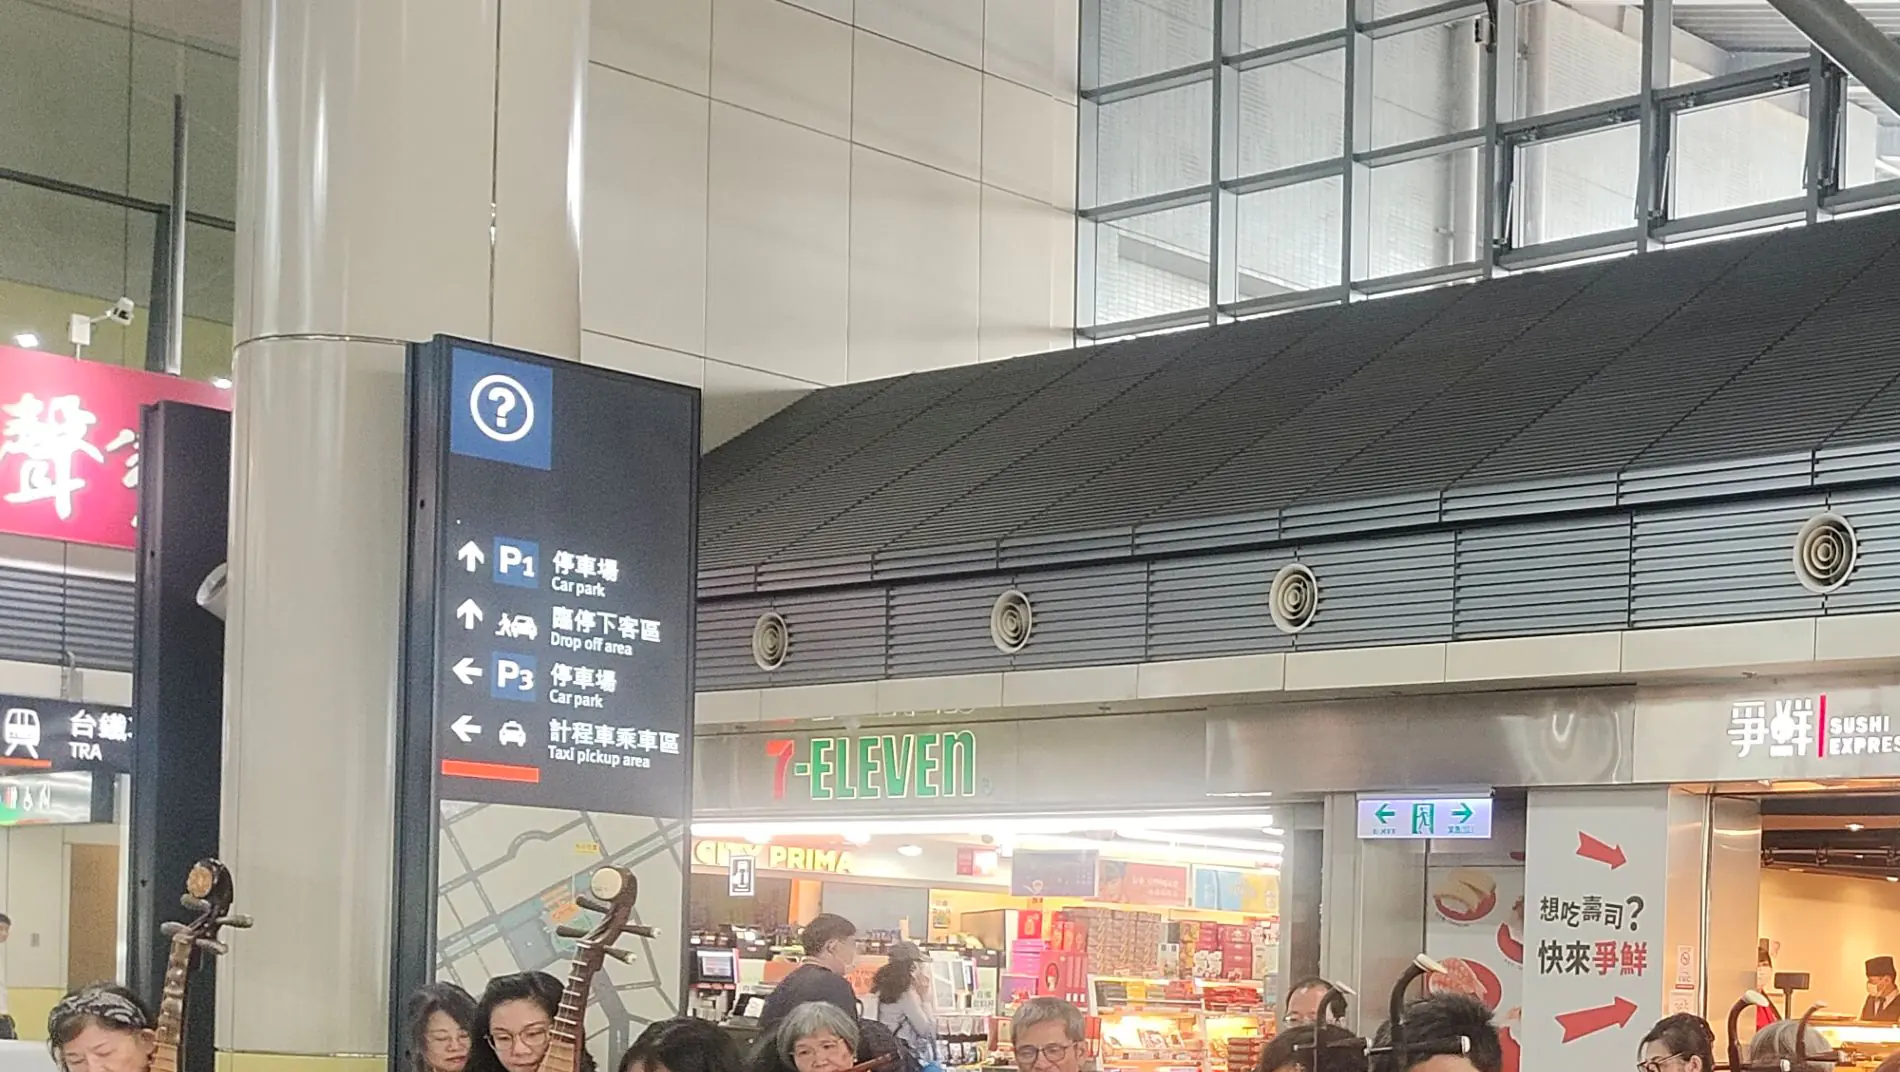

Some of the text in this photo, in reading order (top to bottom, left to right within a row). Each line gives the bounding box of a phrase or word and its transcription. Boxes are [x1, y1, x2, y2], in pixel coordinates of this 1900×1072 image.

[500, 546, 535, 577] P1
[553, 550, 619, 581] 停車場
[552, 577, 606, 598] Car park
[553, 606, 661, 642] 臨停下客區
[551, 631, 633, 656] Drop off area
[498, 660, 534, 691] P3
[551, 662, 618, 693] 停車場
[550, 690, 604, 709] Car park
[70, 709, 134, 742] 台鐵
[549, 718, 680, 755] 計程車乘車區
[1829, 716, 1890, 736] SUSHI
[68, 742, 102, 761] TRA
[548, 746, 651, 769] Taxi pickup area
[769, 845, 852, 875] PRIMA
[1540, 895, 1645, 932] 想吃壽司?
[1538, 940, 1648, 977] 快來爭鮮
